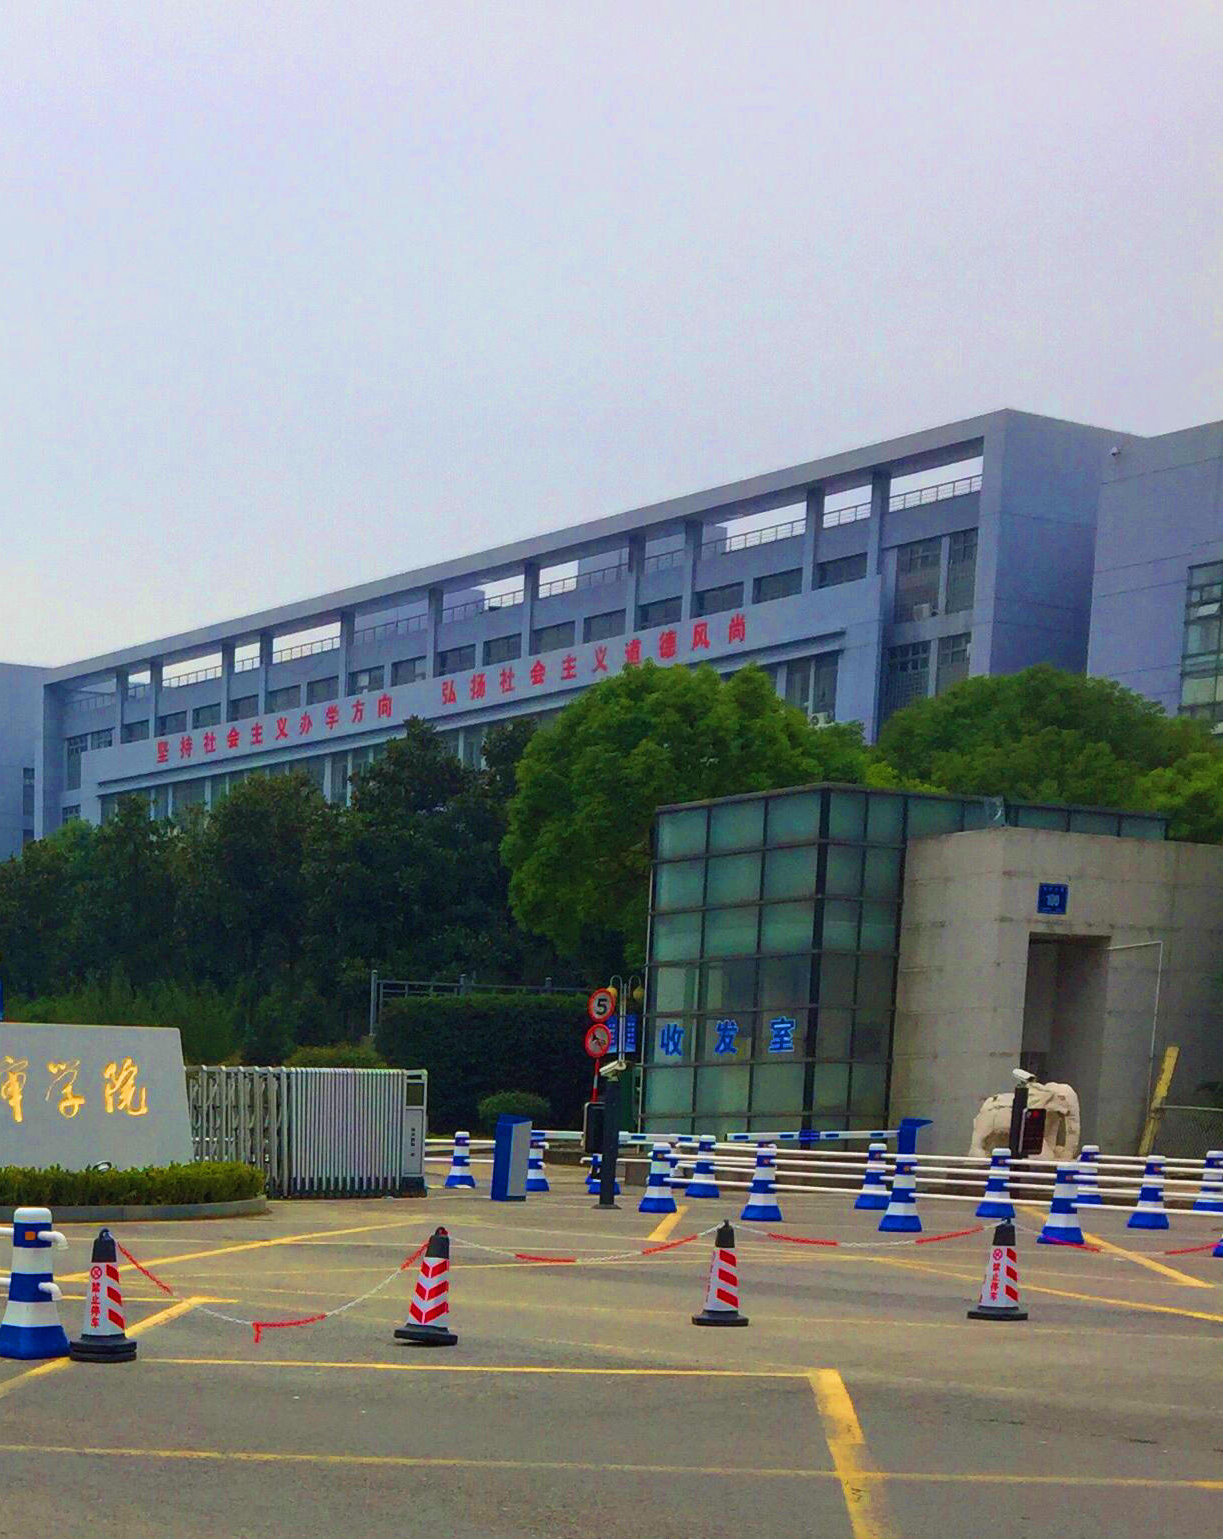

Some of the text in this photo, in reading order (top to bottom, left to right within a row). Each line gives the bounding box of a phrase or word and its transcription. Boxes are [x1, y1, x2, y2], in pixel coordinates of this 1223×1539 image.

[157, 612, 746, 764] 坚持社会主义办学方向 弘扬社会主义道德风尚
[596, 998, 608, 1015] 5
[660, 1016, 796, 1056] 收发室
[90, 1282, 101, 1328] 禁止停车
